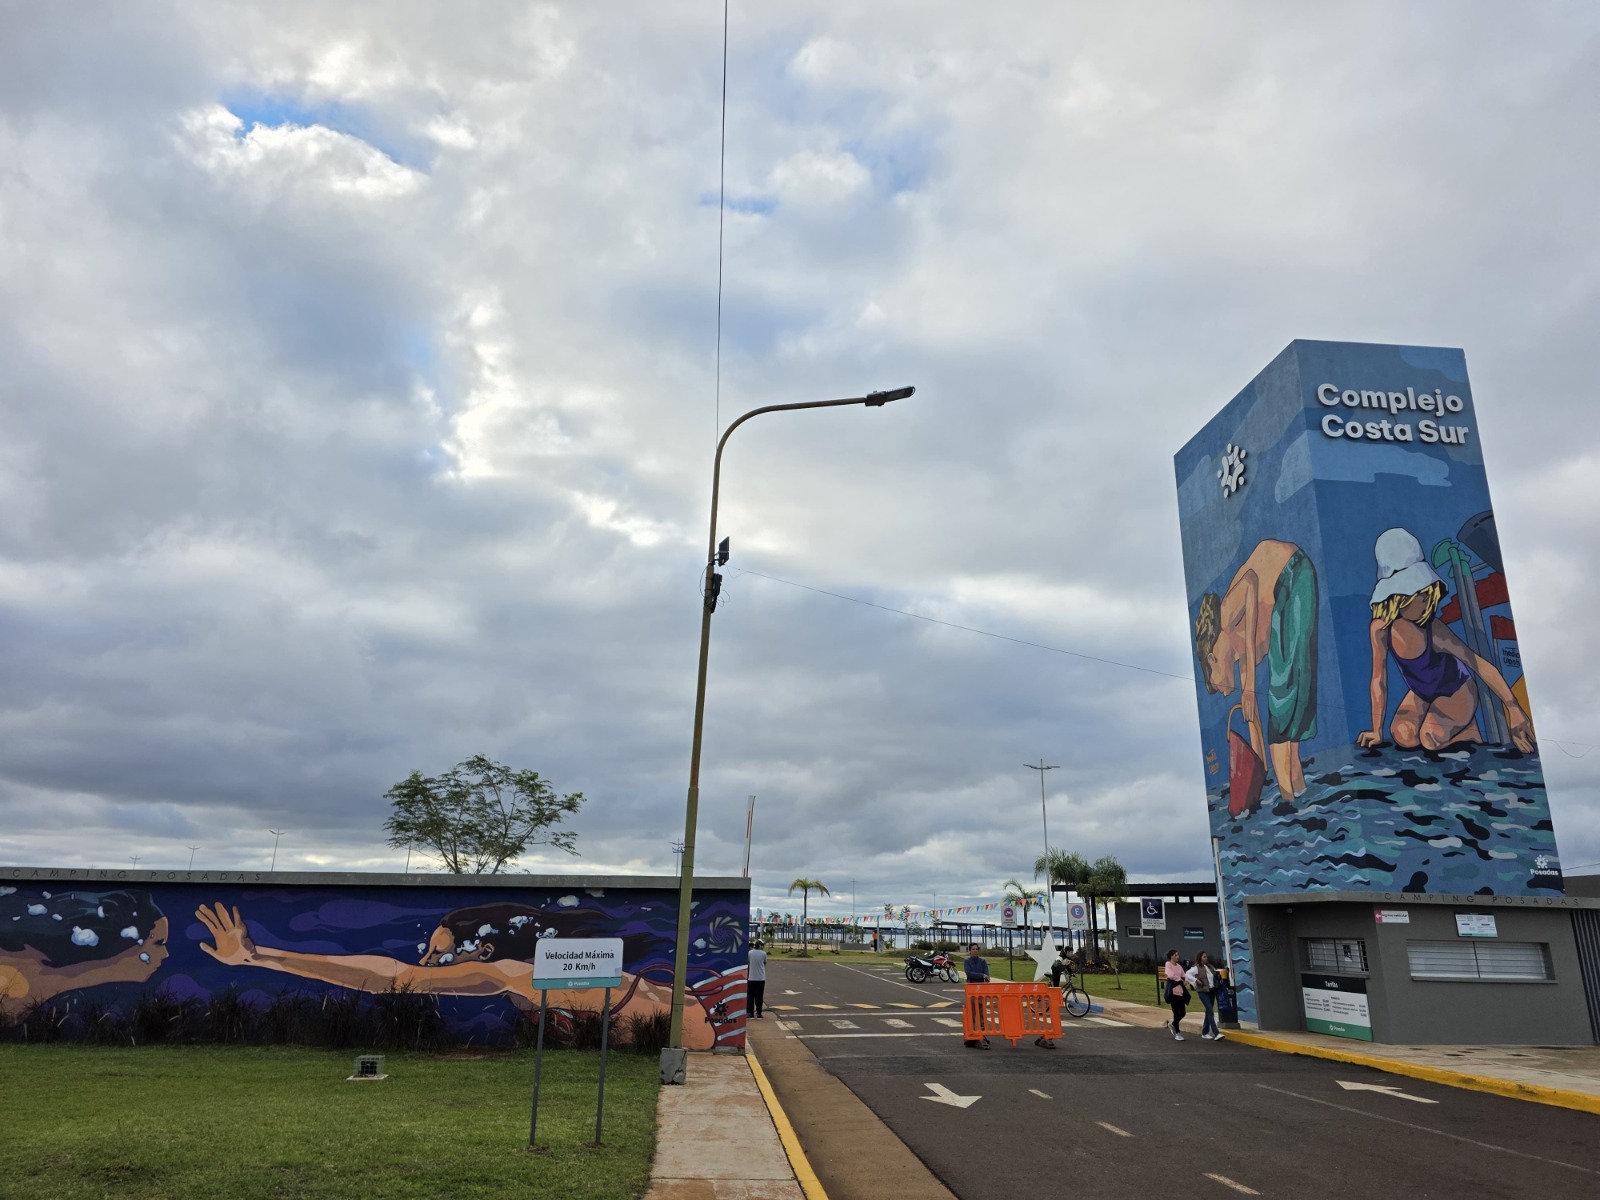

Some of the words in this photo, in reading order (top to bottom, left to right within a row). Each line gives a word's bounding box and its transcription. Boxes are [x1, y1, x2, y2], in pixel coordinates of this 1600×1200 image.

[1317, 383, 1464, 417] Complejo
[1321, 414, 1414, 442] Costa
[1418, 419, 1469, 444] Sur
[12, 868, 128, 880] CAMPING
[150, 871, 261, 882] POSADAS
[1530, 868, 1559, 876] Posadas
[1384, 892, 1475, 903] CAMPING
[1492, 896, 1580, 906] POSADAS
[545, 951, 584, 960] Velocidad
[584, 949, 615, 960] Máxima
[562, 963, 573, 971] 20
[575, 962, 596, 972] Km/h
[704, 1016, 738, 1024] Posadas
